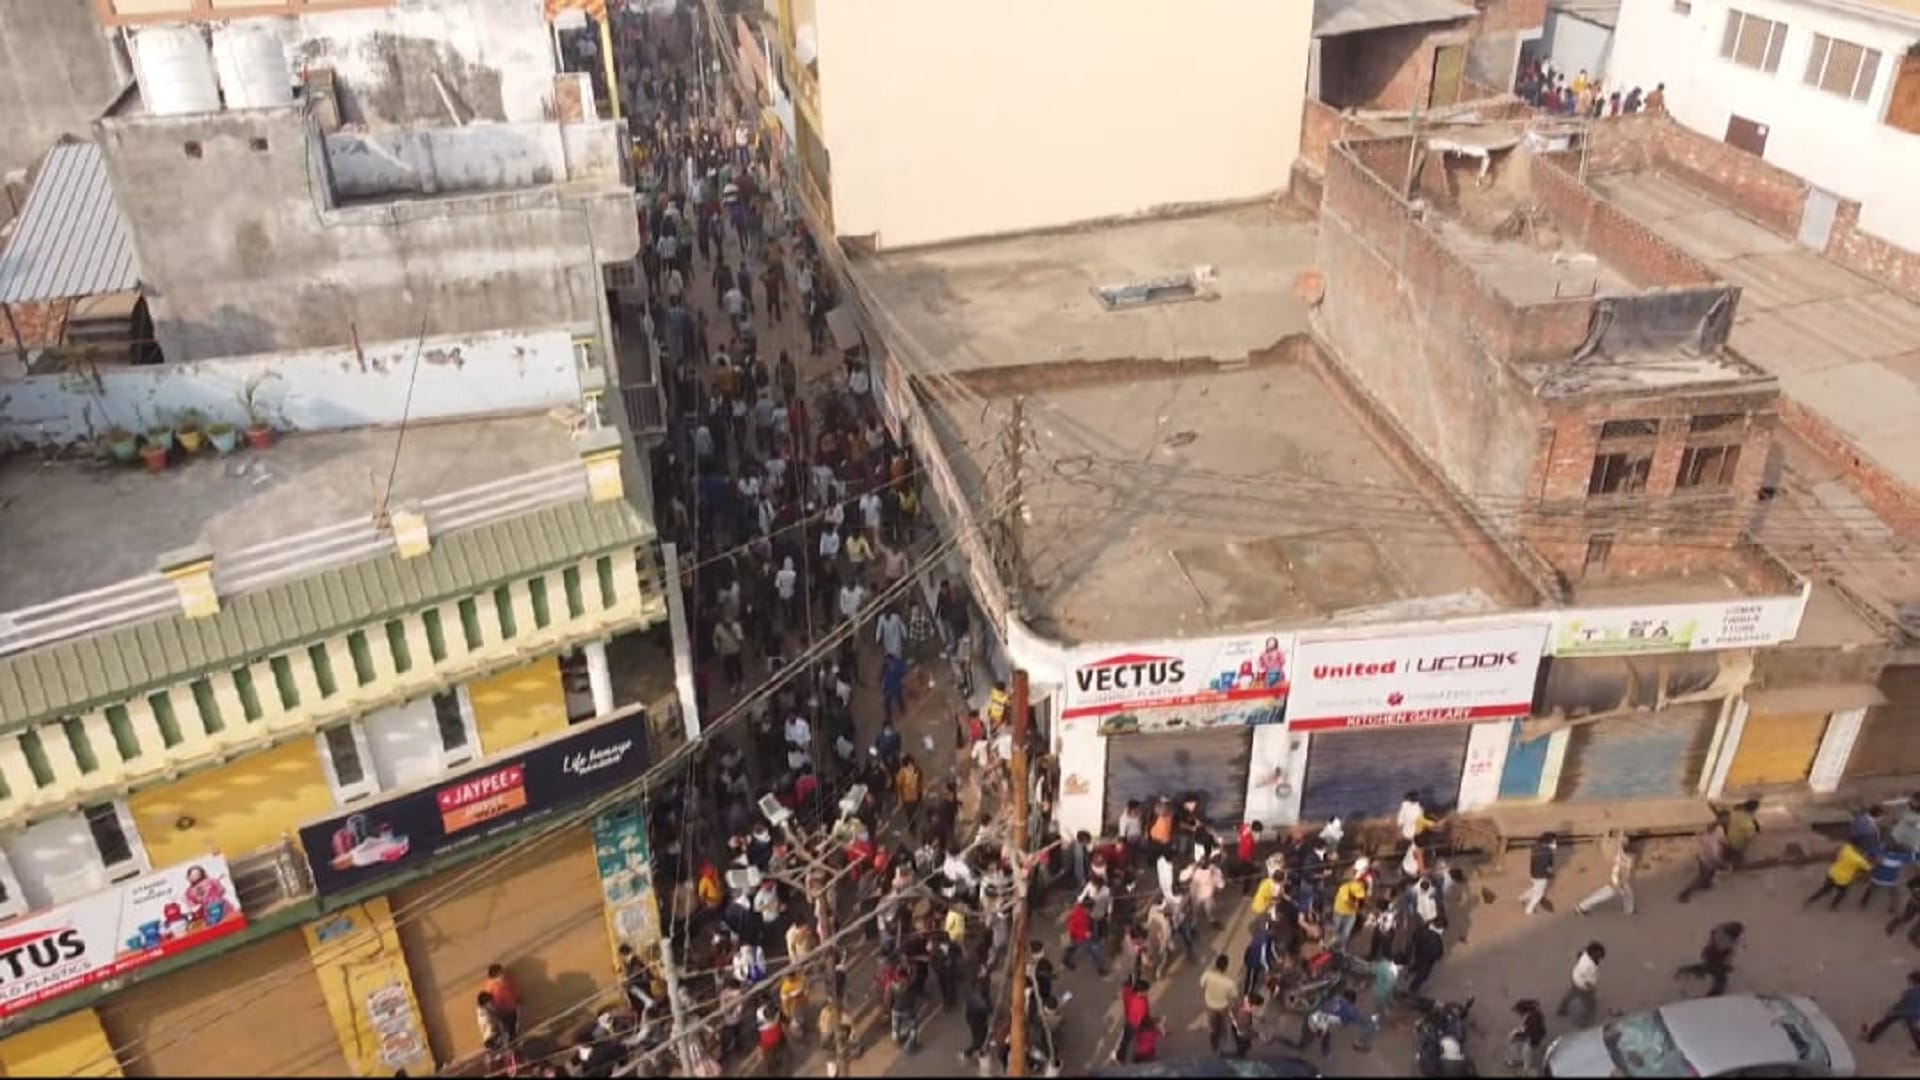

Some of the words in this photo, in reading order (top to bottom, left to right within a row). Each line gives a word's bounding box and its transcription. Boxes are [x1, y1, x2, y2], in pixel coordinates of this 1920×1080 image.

[1076, 659, 1184, 692] VECTUS
[1313, 659, 1396, 679] United
[1416, 651, 1520, 673] UCOOK
[1346, 710, 1405, 727] KITCHEN
[454, 770, 509, 804] JAYPEE
[0, 929, 86, 985] TUS
